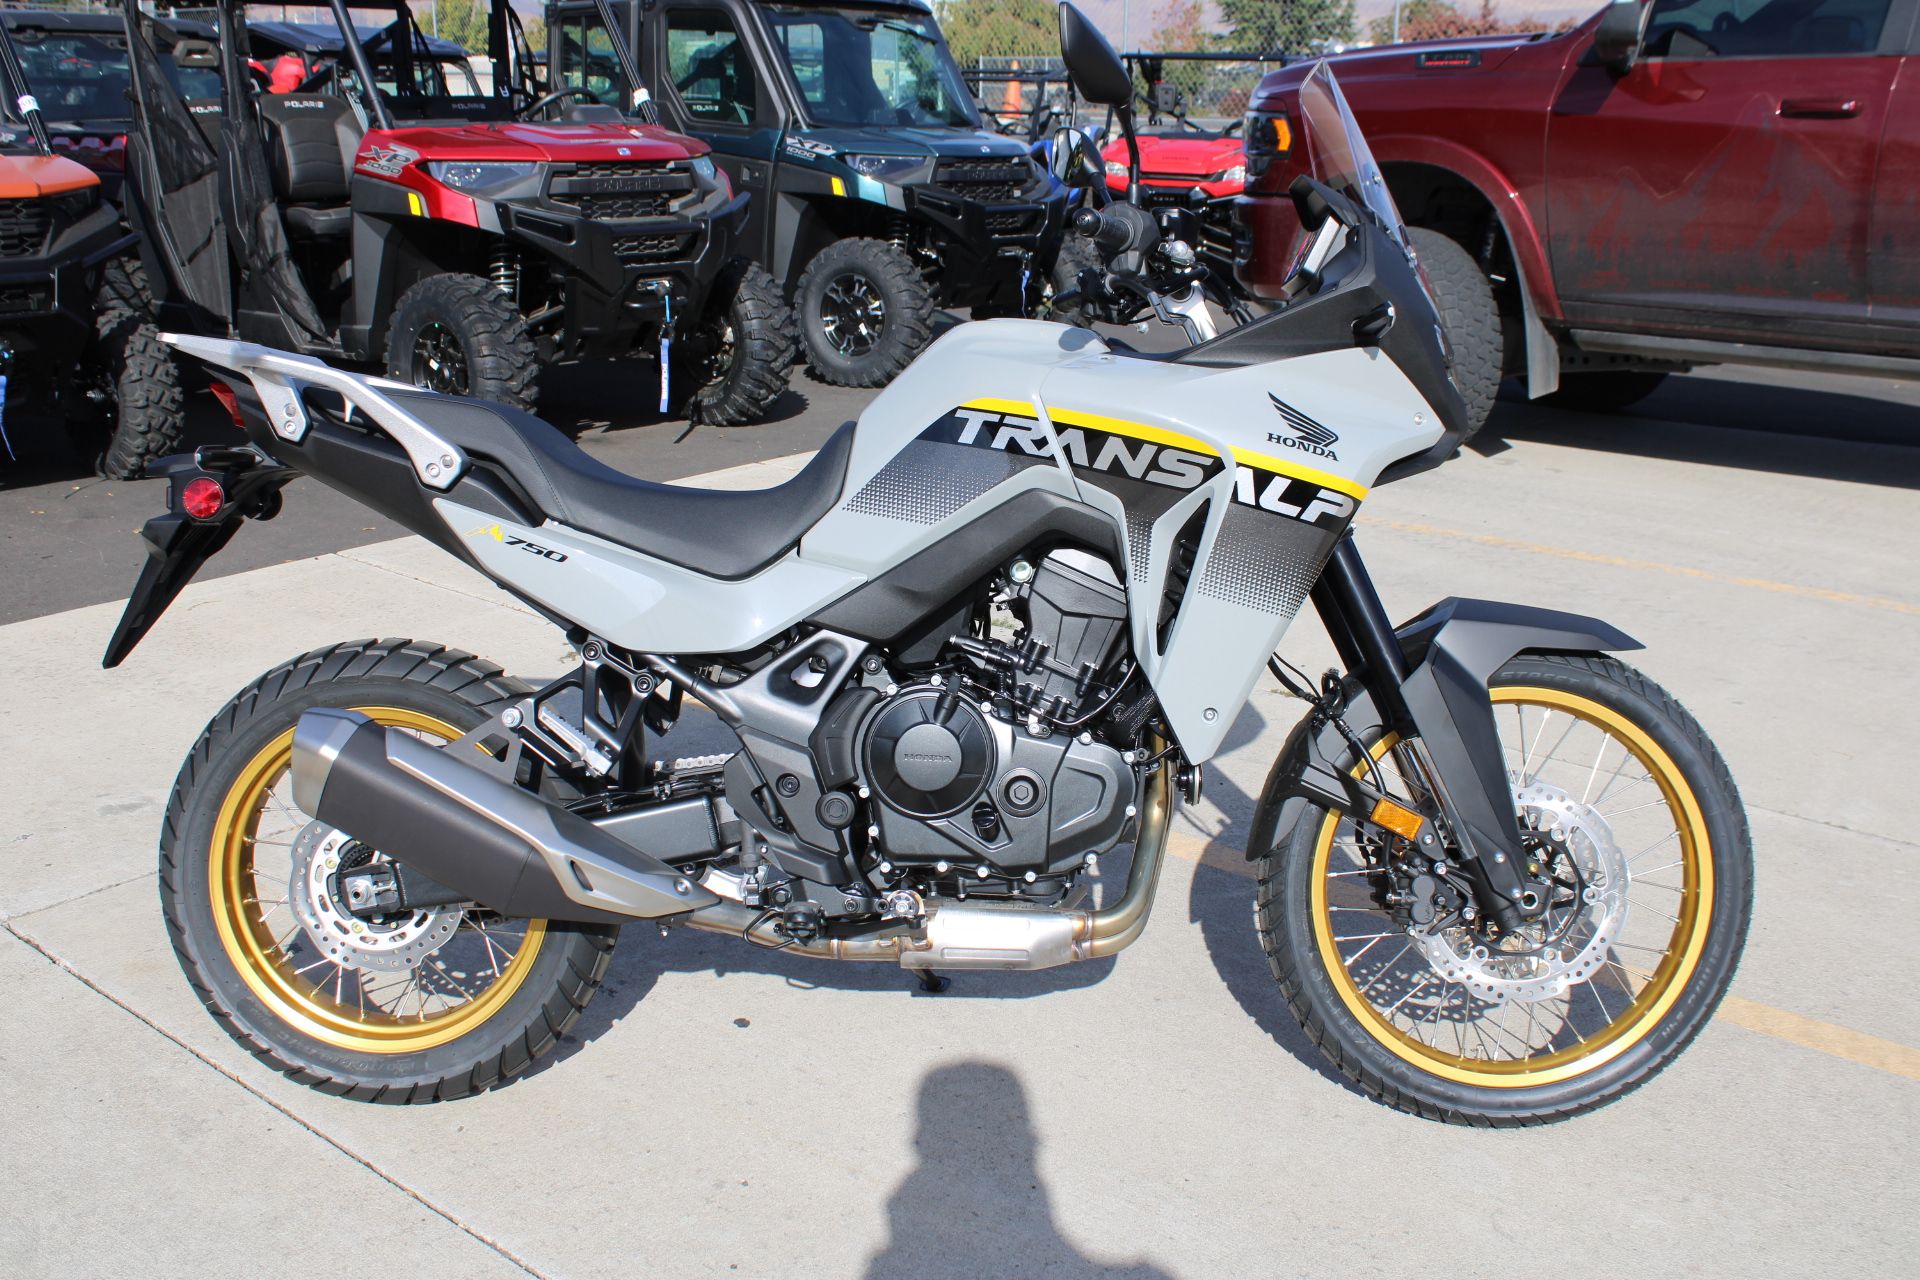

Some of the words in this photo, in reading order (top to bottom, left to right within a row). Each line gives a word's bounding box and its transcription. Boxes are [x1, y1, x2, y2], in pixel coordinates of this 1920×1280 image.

[786, 146, 817, 159] 1000
[367, 160, 402, 175] 1000
[1266, 432, 1339, 461] HONDA
[505, 536, 568, 562] 750
[904, 753, 952, 763] HONDA
